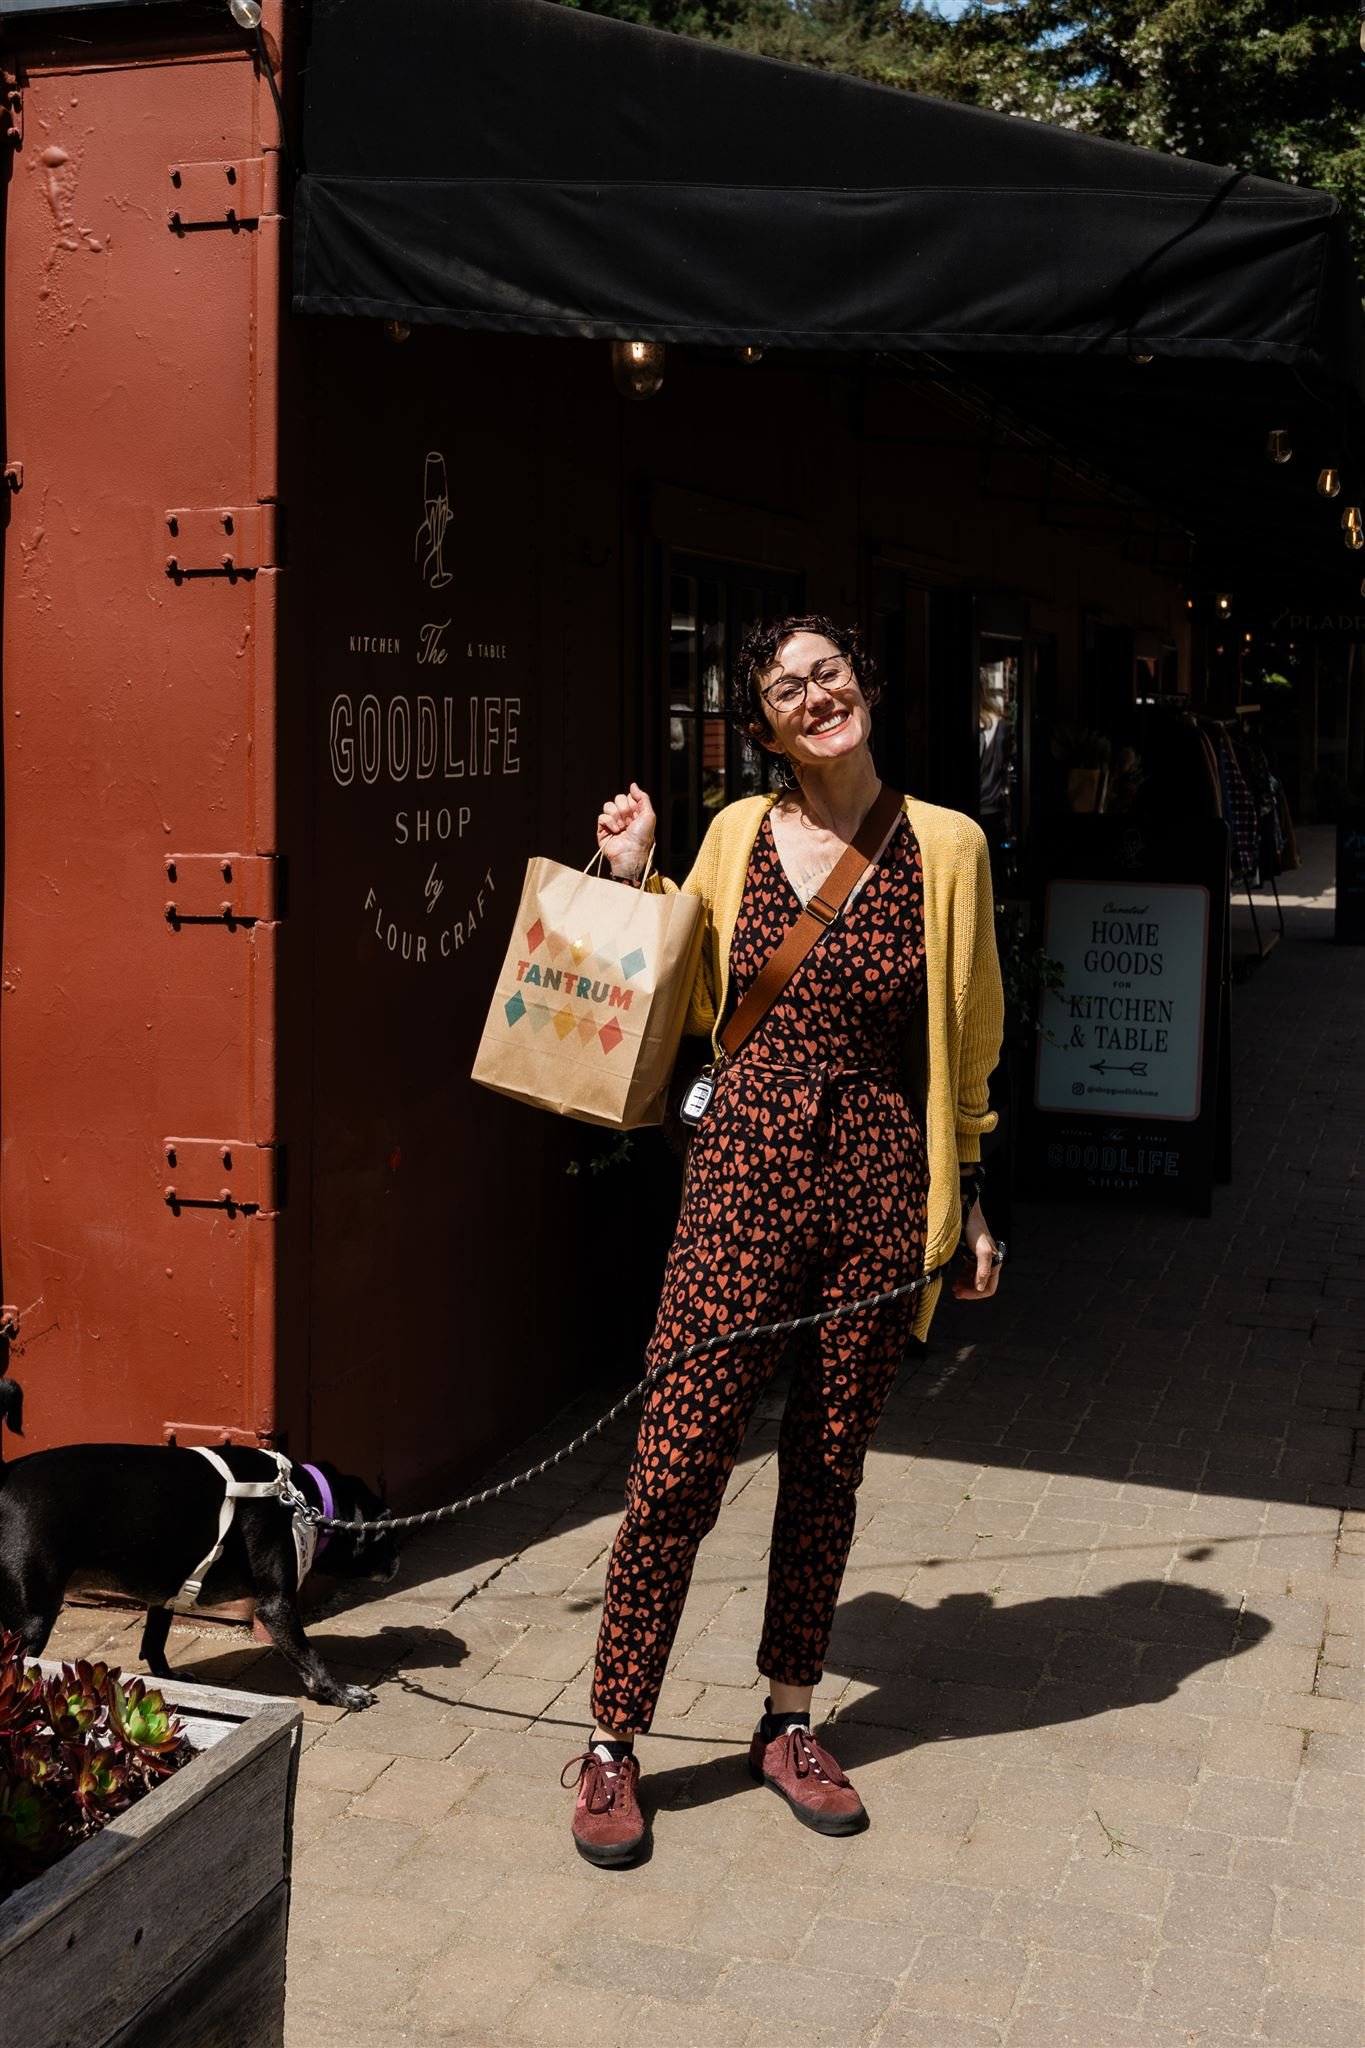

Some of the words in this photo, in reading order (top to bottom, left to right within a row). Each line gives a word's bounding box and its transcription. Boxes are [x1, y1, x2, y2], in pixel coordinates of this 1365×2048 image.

[349, 635, 400, 655] KITCHEN
[416, 617, 452, 665] The
[467, 644, 473, 658] &
[476, 643, 507, 660] TABLE
[330, 693, 521, 786] GOODLIFE
[394, 806, 472, 845] SHOP
[424, 862, 444, 912] by
[364, 888, 427, 963] FLOUR
[439, 867, 497, 958] CRAFT
[1091, 920, 1160, 947] HOME
[1084, 950, 1164, 977] GOODS
[515, 960, 634, 1011] TANTRUM
[1113, 980, 1132, 989] FOR
[1069, 995, 1174, 1023] KITCHEN
[1070, 1024, 1086, 1049] &
[1094, 1025, 1169, 1053] TABLE
[1048, 1143, 1180, 1176] GOODLIFE
[1088, 1175, 1138, 1189] SHOP
